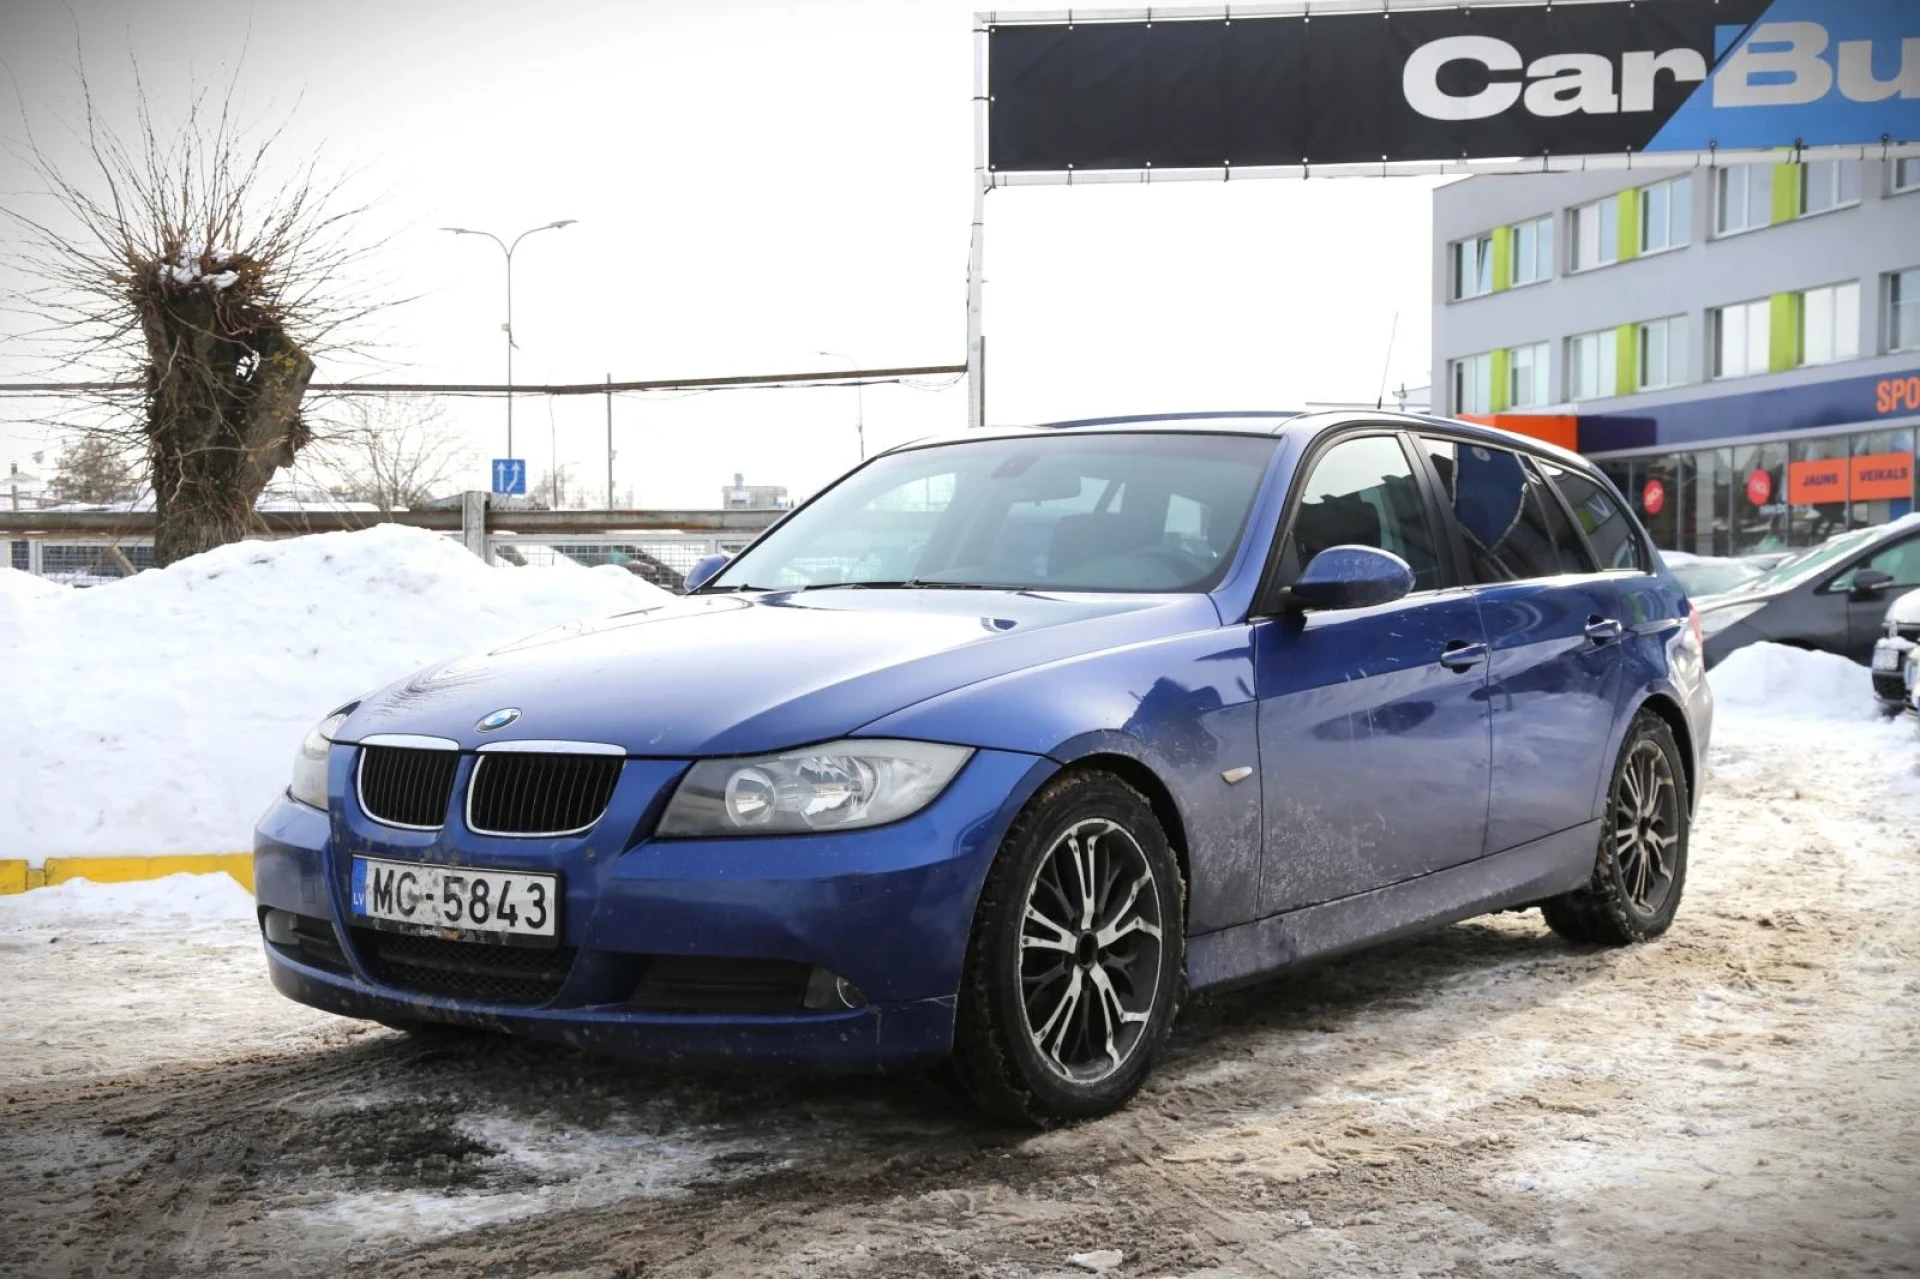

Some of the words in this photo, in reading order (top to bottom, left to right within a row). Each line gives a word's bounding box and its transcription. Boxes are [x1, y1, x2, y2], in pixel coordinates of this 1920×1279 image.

[1876, 377, 1920, 413] SPO
[1860, 467, 1908, 482] VEIKALS
[353, 892, 365, 906] LV
[373, 867, 547, 929] MC-5843
